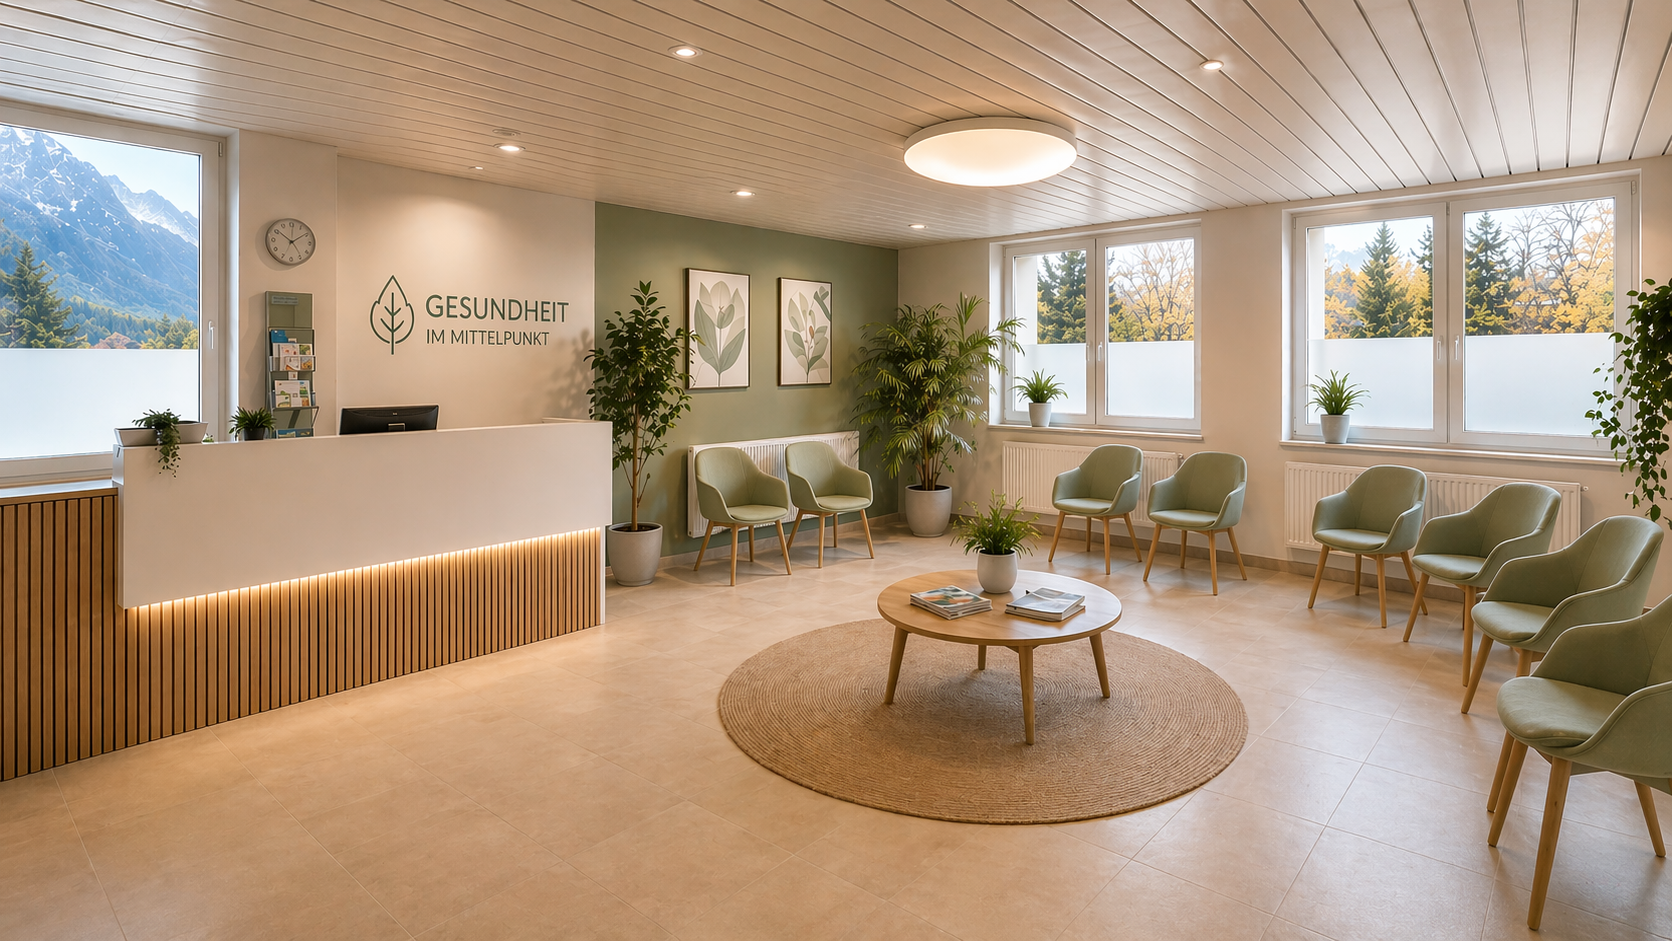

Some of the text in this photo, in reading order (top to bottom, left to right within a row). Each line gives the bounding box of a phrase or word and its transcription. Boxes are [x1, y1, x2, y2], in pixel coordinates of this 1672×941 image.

[425, 294, 570, 323] GESUNDHEIT
[426, 329, 550, 346] IM MITTELPUNKT
